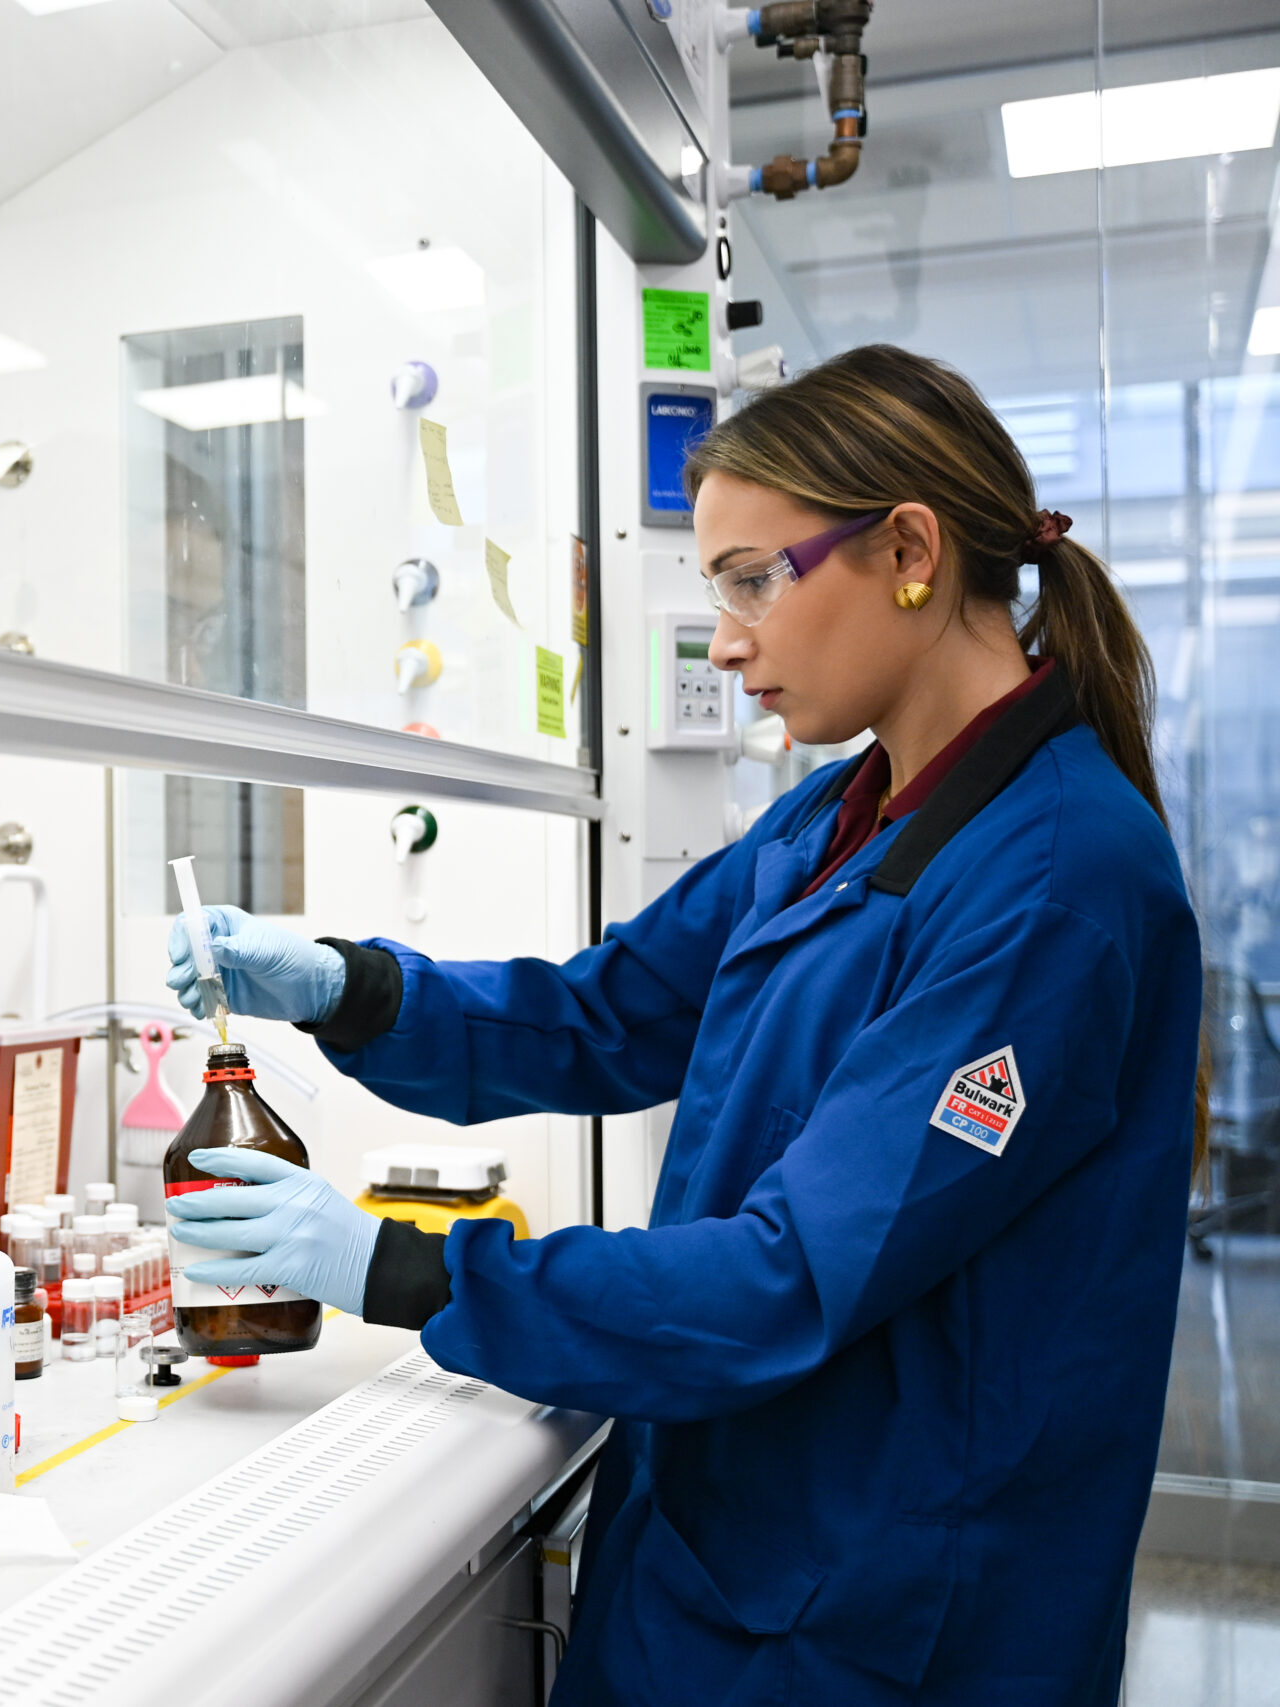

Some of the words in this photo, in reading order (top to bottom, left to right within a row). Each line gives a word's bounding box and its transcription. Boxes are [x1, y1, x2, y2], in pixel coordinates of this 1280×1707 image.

[950, 1098, 967, 1113] FR
[968, 1108, 981, 1118] CAT
[953, 1080, 1014, 1118] Bulwark
[951, 1115, 969, 1128] CP
[969, 1123, 989, 1139] 100
